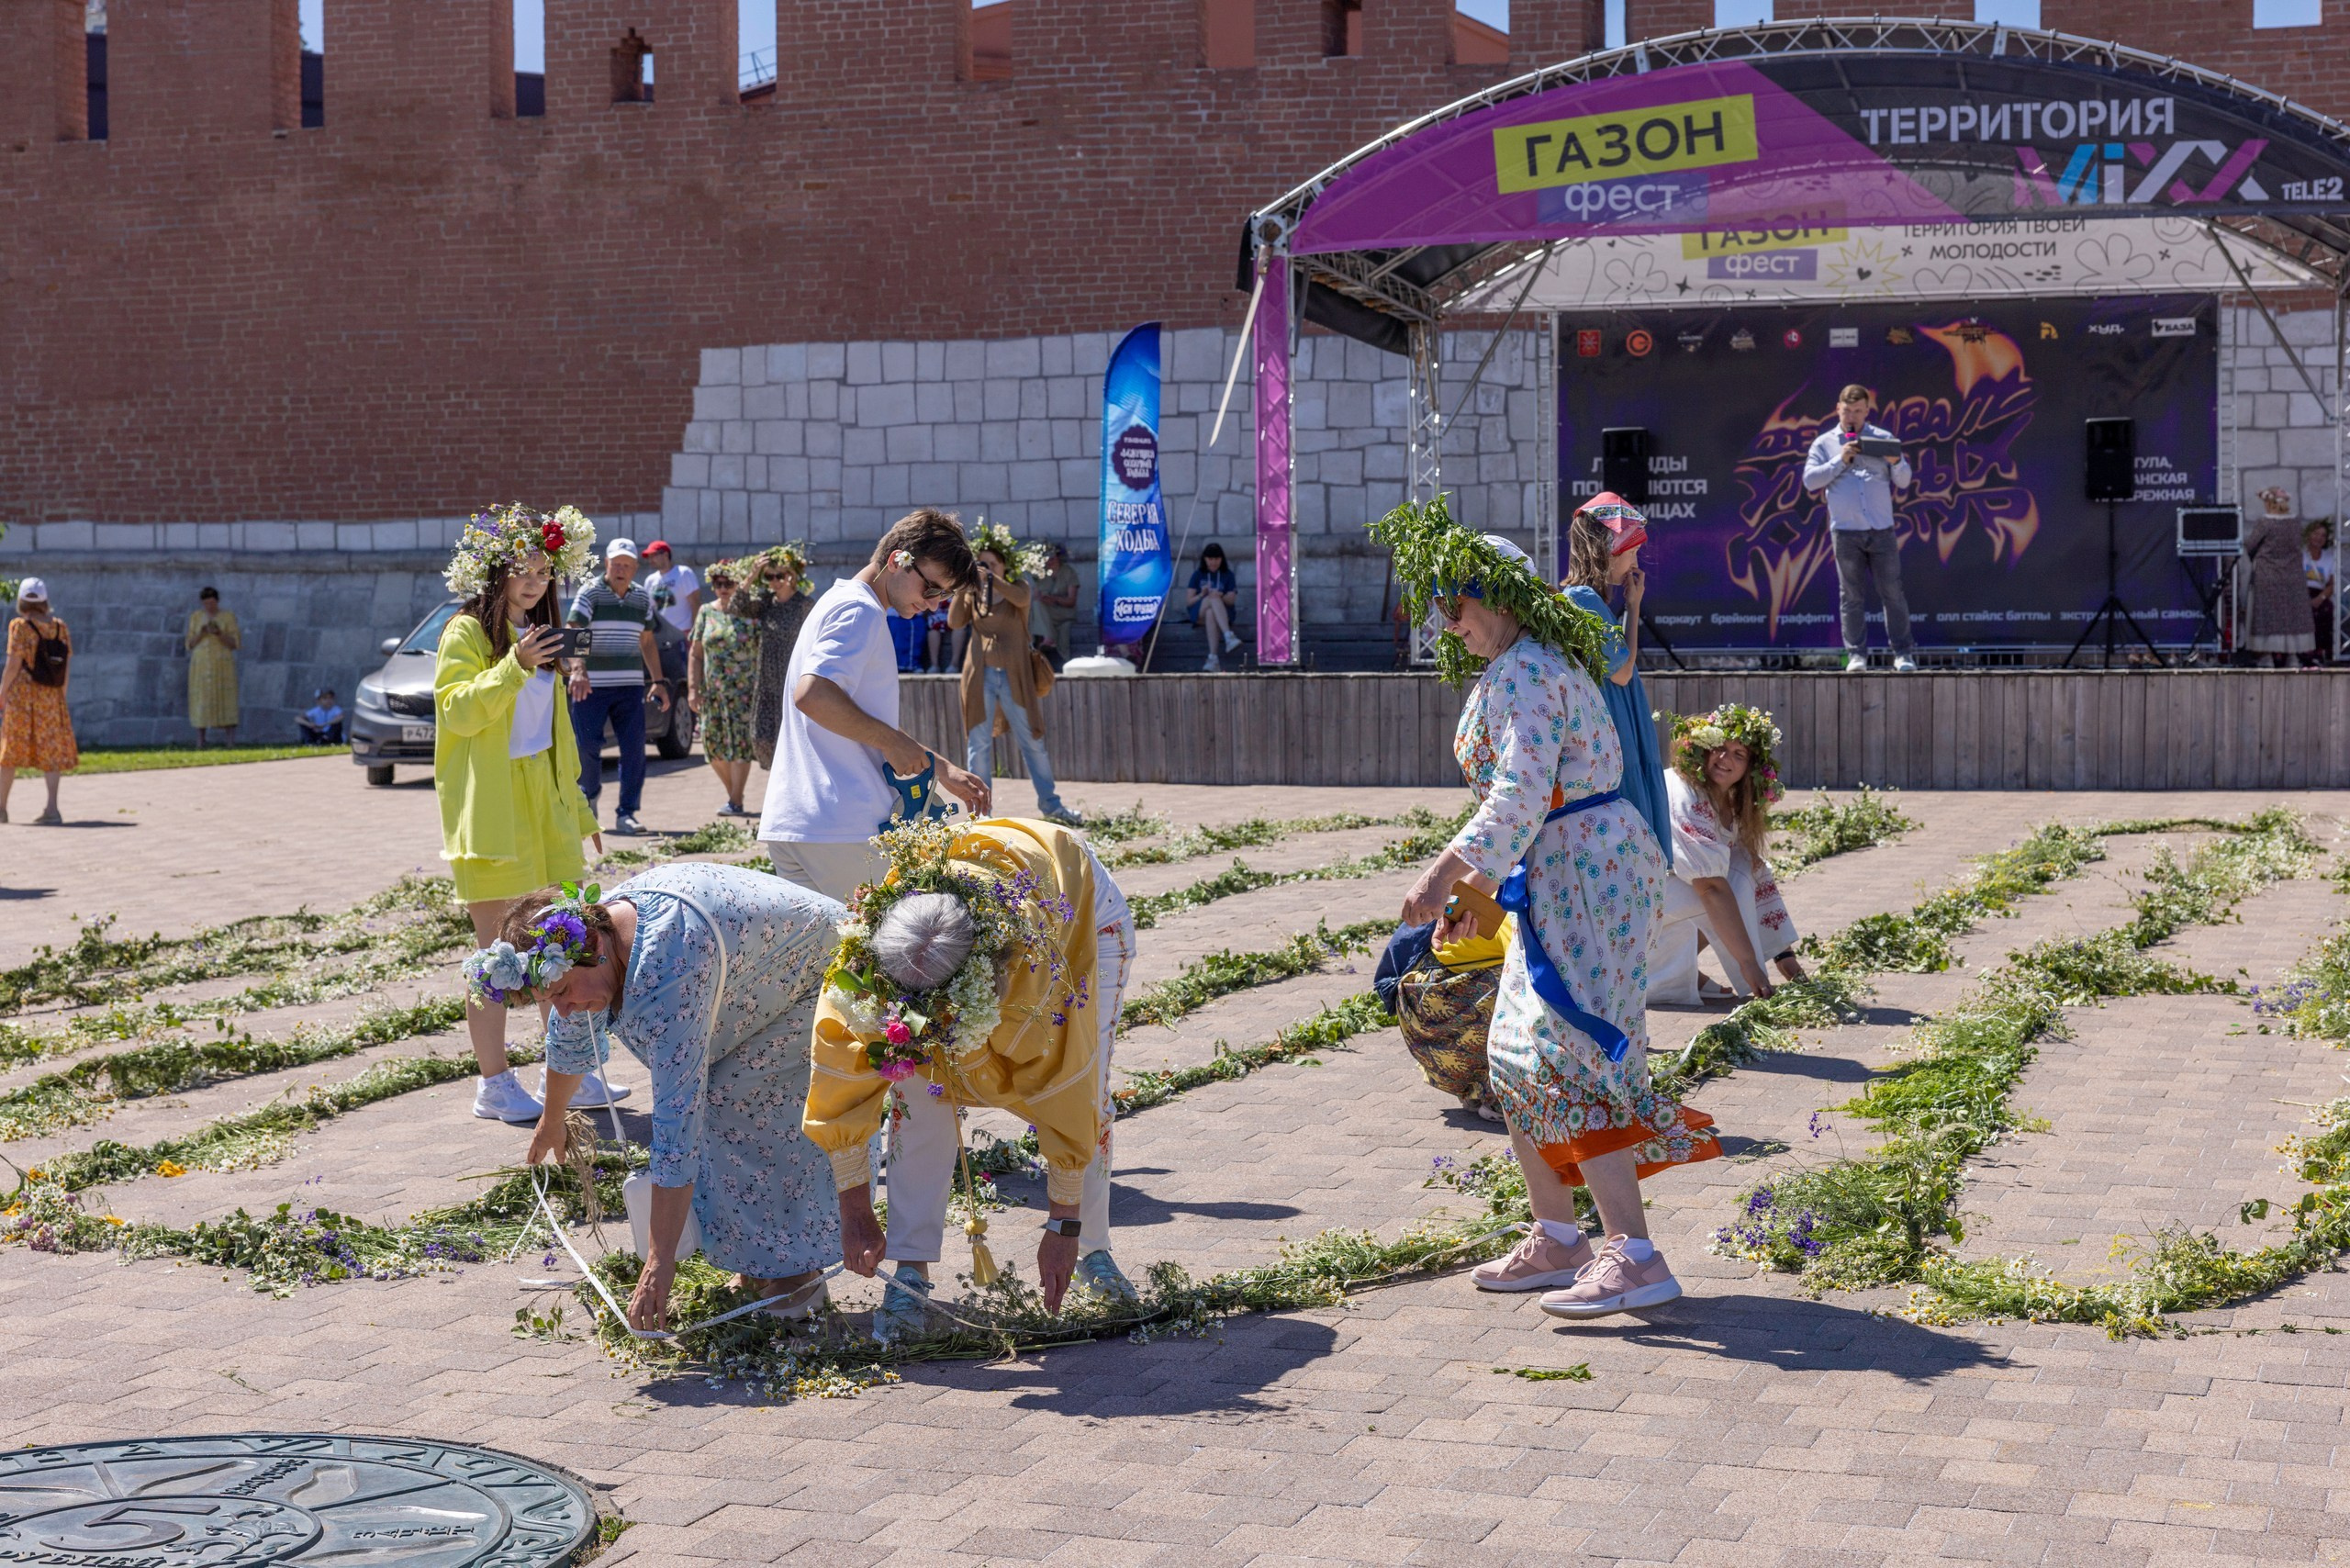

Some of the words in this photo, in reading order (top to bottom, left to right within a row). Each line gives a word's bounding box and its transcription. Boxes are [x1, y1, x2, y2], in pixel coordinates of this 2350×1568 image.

[1860, 97, 2175, 145] ТЕРРИТОРИЯ
[1525, 111, 1725, 177] ГАЗОН
[1565, 181, 1681, 221] фест
[2281, 176, 2344, 201] TELE2
[1930, 241, 2057, 260] МОЛОДОСТИ
[1725, 253, 1800, 278] фест
[1655, 615, 1703, 625] воркаут
[1711, 613, 1766, 624] брейкинг
[1775, 613, 1834, 624] граффити
[1936, 612, 1960, 622] олл
[1963, 610, 2003, 622] стайлс
[2006, 610, 2051, 621] баттлы
[39, 1504, 221, 1551] 5
